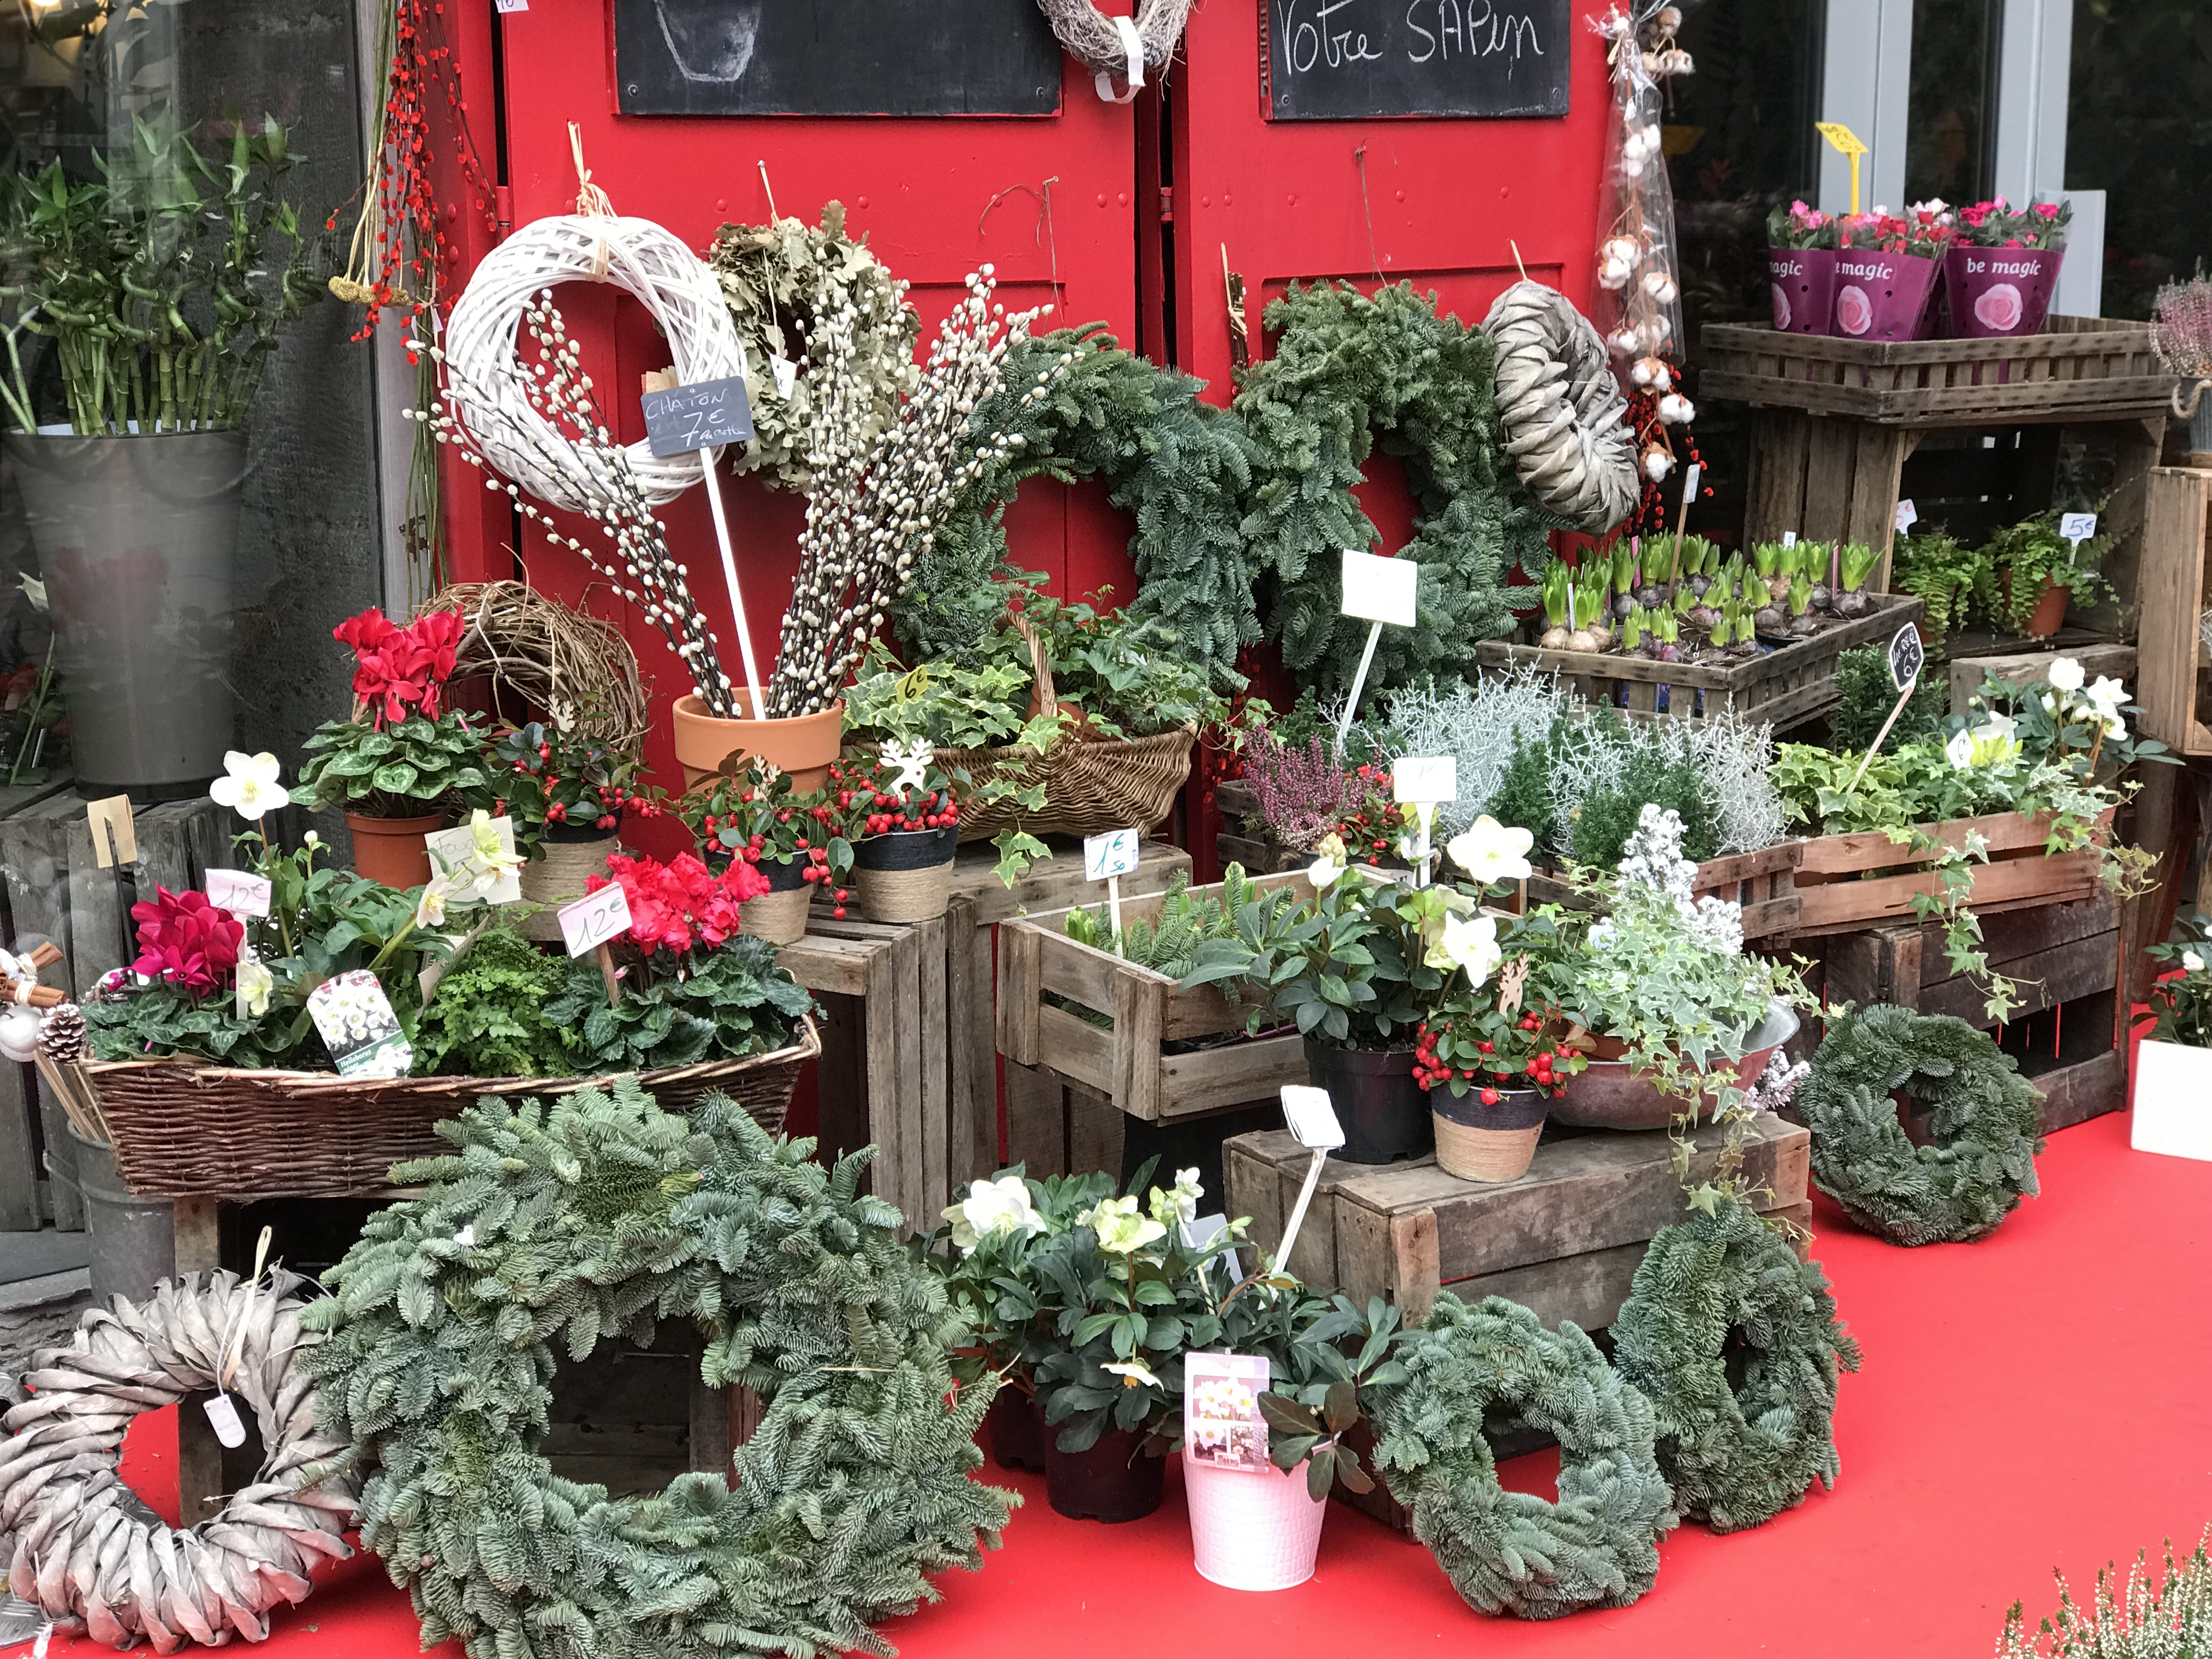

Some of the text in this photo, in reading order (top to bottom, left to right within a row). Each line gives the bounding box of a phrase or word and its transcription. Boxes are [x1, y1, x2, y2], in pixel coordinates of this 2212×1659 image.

[1842, 262, 1893, 281] magic
[1967, 257, 2042, 278] be magic
[645, 388, 729, 420] CHATON
[2065, 518, 2095, 537] 5€
[905, 667, 926, 699] 6€
[216, 882, 269, 911] 12€
[573, 896, 625, 951] 12€
[340, 1049, 373, 1068] Helleborus
